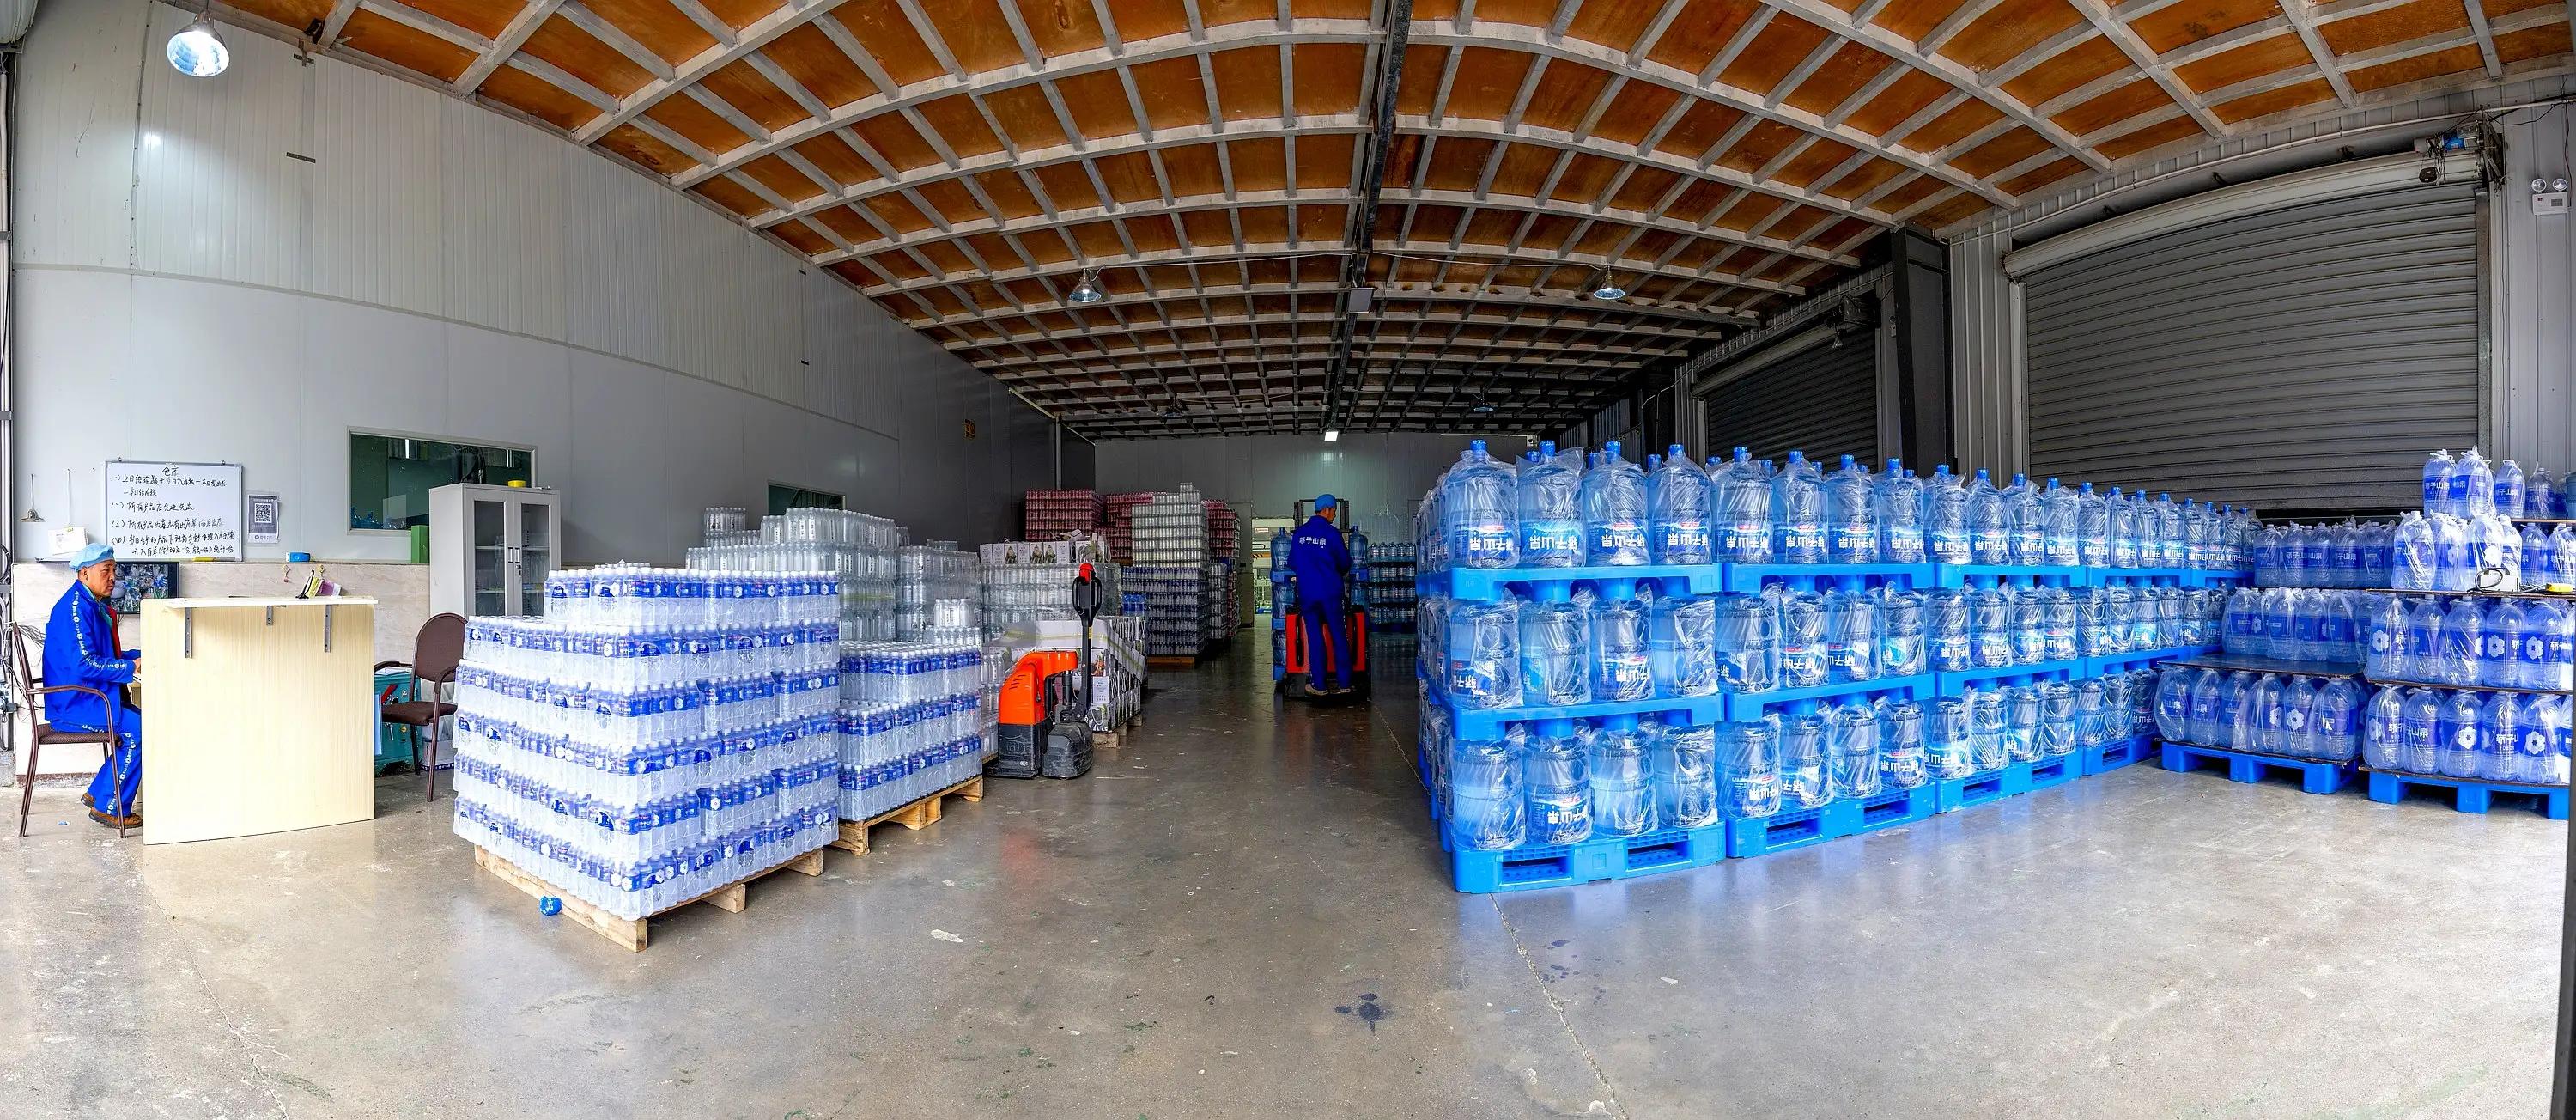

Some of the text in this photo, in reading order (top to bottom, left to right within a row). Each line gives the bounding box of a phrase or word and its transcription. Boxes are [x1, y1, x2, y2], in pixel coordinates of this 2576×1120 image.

[1529, 536, 1578, 551] 轿子山泉
[1601, 533, 1646, 547] 轿子山泉
[1668, 533, 1709, 546] 轿子山泉
[1726, 535, 1769, 549] 轿子山泉
[1786, 535, 1825, 548] 轿子山泉
[1838, 537, 1875, 549] 轿子山泉
[1881, 760, 1919, 772] 轿子山泉
